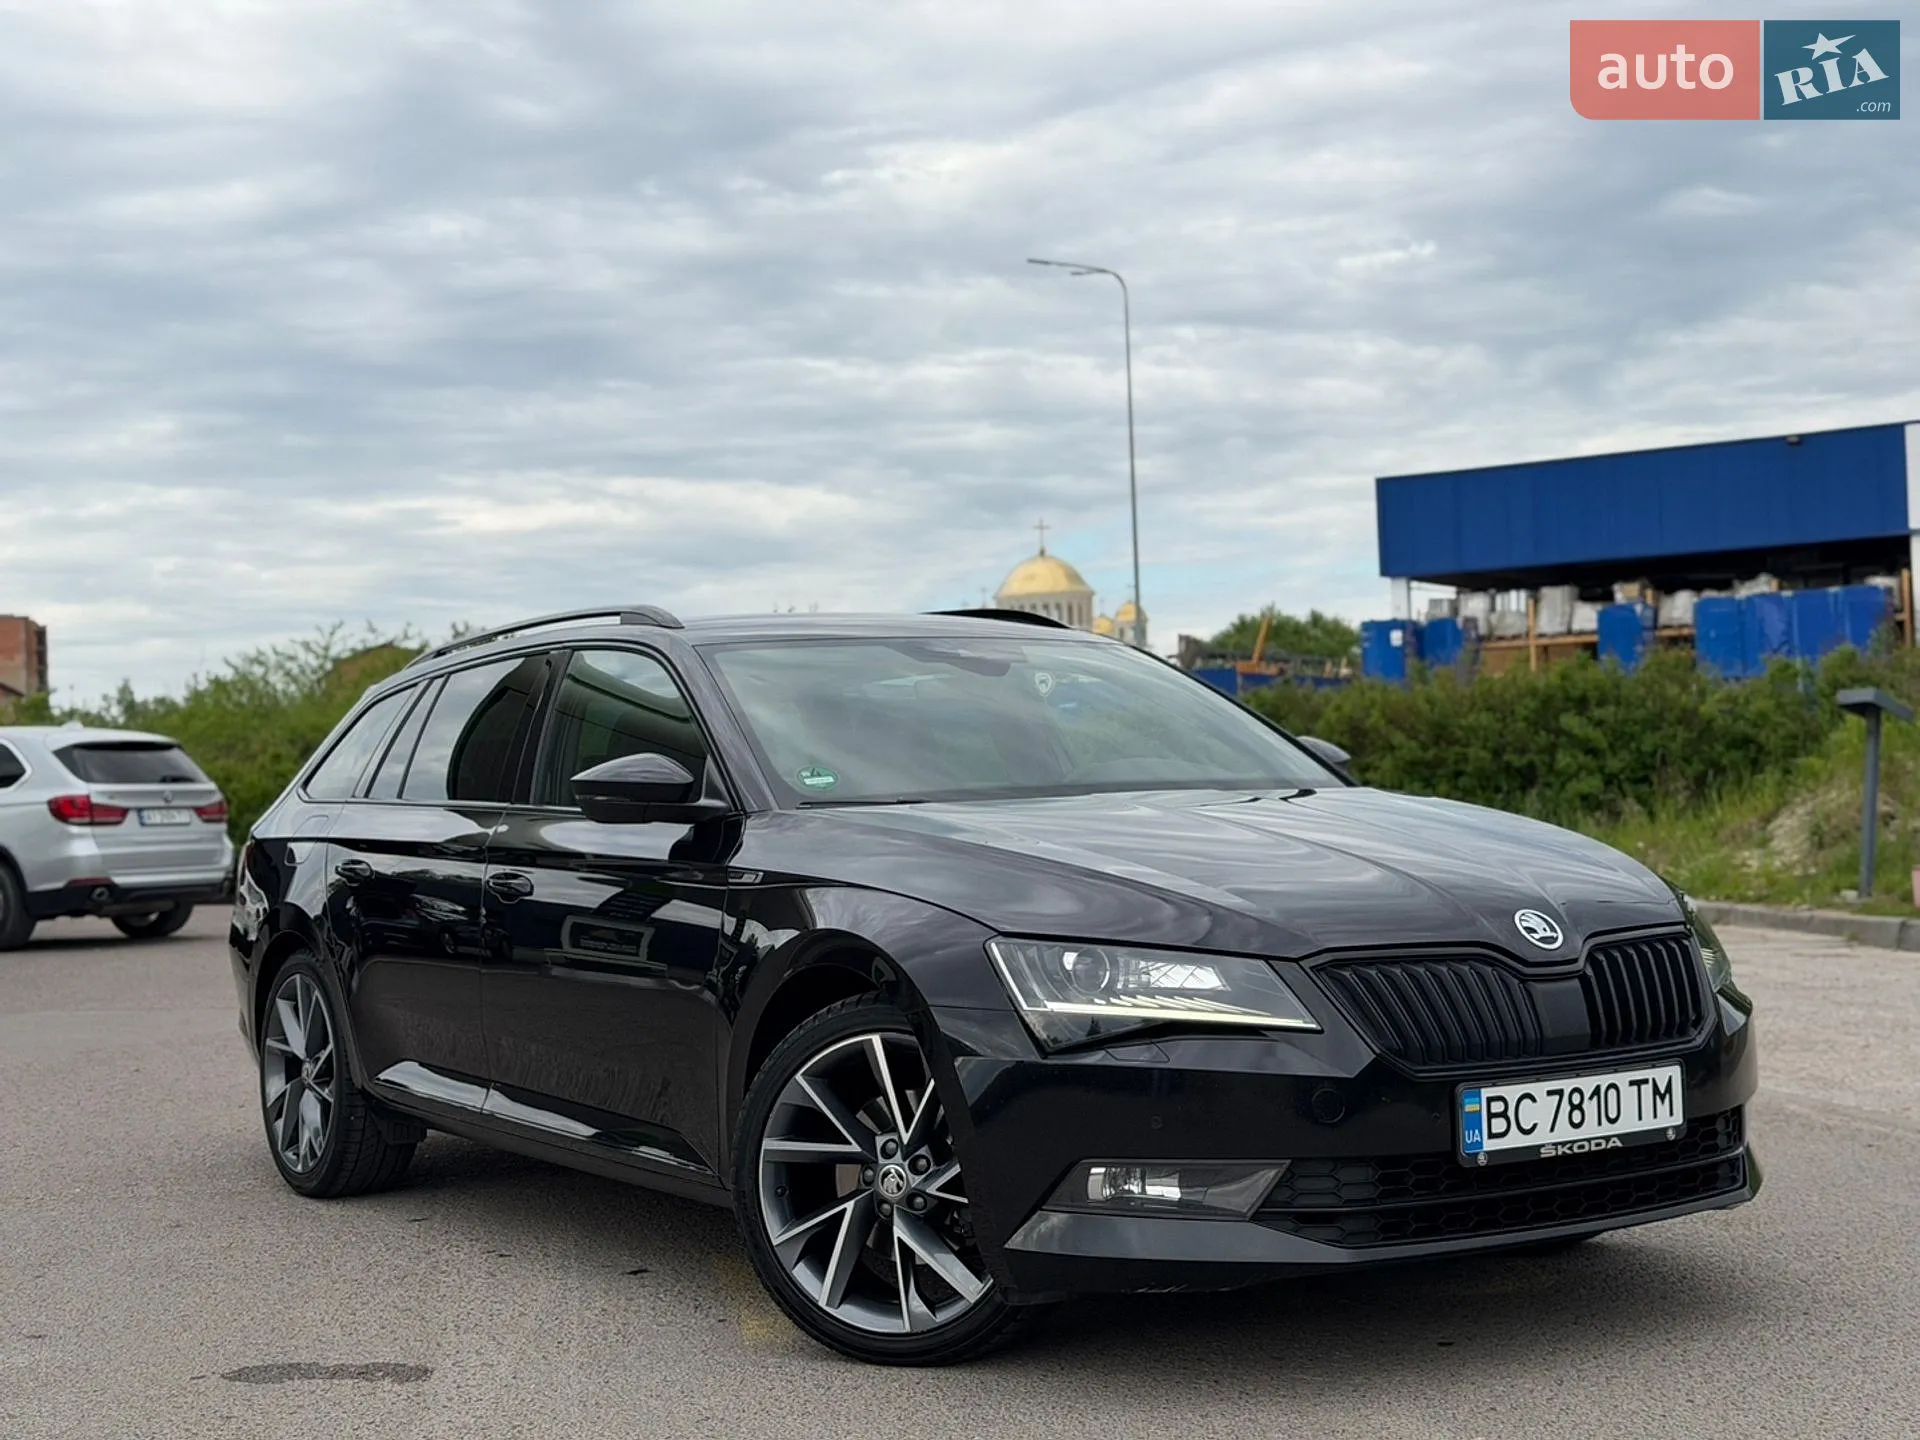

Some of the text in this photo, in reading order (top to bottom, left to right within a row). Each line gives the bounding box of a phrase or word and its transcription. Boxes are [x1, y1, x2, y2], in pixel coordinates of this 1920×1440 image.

[1485, 1075, 1675, 1140] BC 7810 TM
[1465, 1128, 1481, 1144] UA
